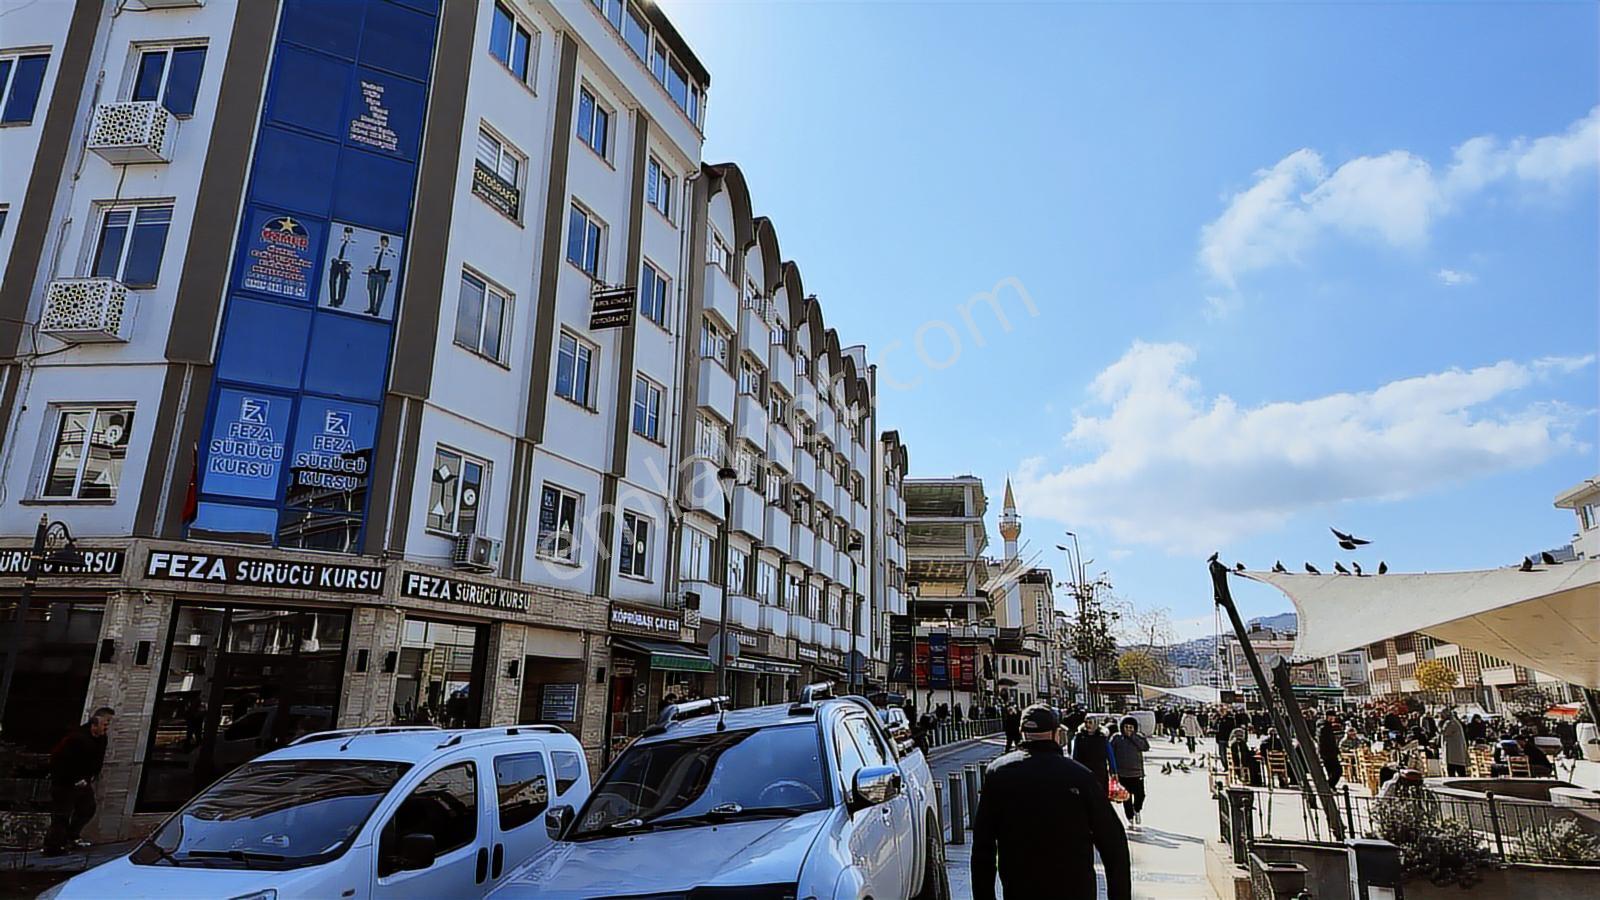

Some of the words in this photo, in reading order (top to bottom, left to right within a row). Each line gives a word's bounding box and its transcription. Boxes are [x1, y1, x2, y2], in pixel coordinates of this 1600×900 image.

[229, 422, 274, 441] FEZA
[209, 437, 284, 460] SÜRÜCÜ
[313, 435, 356, 453] FEZA
[210, 457, 274, 478] KURSU
[296, 451, 367, 473] SÜRÜCÜ
[298, 470, 358, 491] KURSU
[59, 551, 118, 573] RSU
[148, 553, 227, 581] FEZA
[235, 561, 314, 585] SÜRÜCÜ
[320, 567, 382, 590] KURSU
[407, 574, 451, 600] FEZA
[455, 583, 497, 605] SÜRÜCÜ
[498, 589, 531, 610] KURSU
[655, 617, 667, 632] ÇAY
